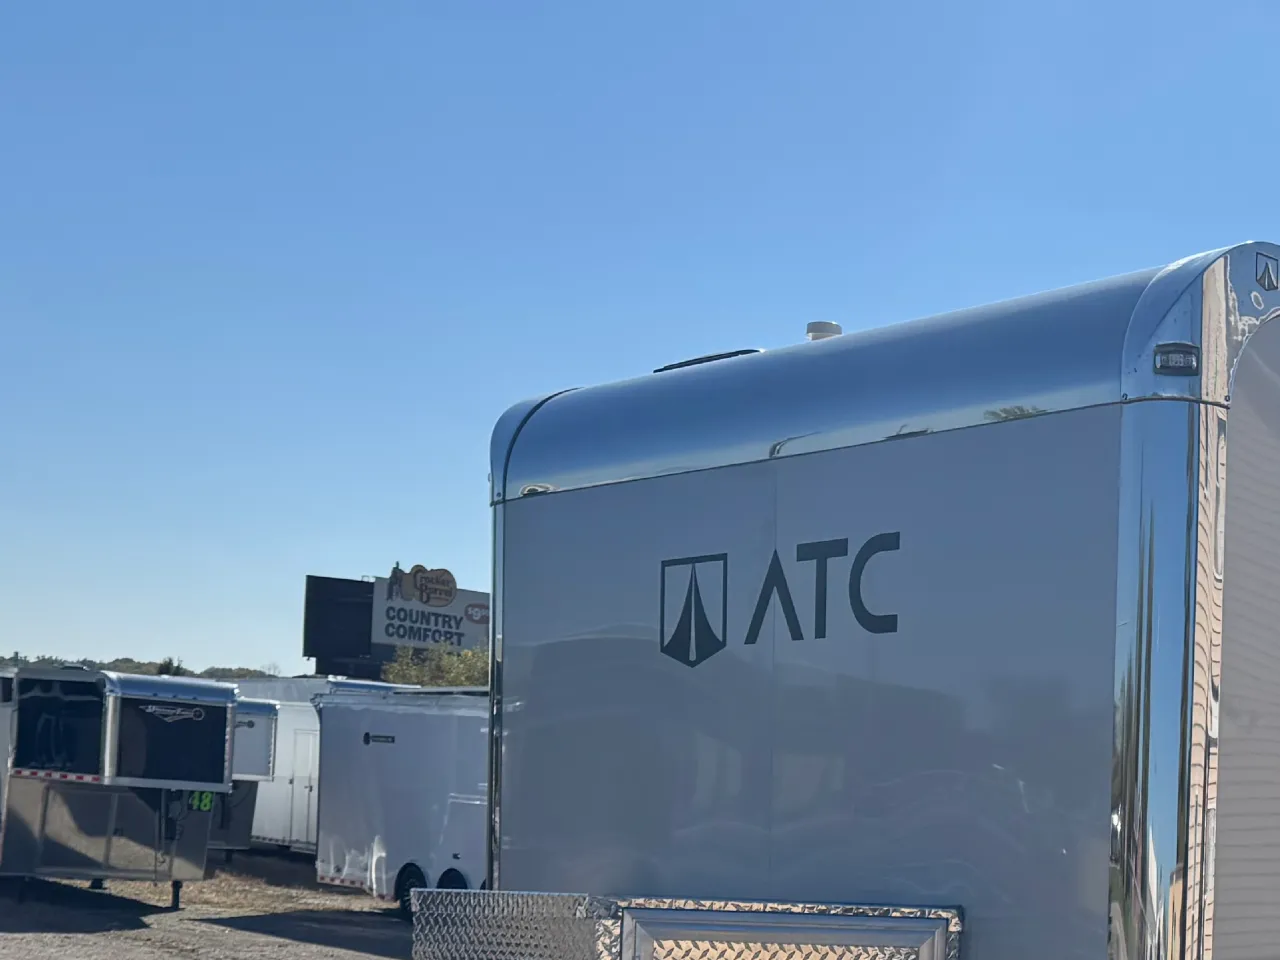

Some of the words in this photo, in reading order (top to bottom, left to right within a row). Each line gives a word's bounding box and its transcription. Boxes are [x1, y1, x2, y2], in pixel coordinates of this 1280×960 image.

[744, 531, 900, 645] ATC
[386, 606, 463, 630] COUNTRY
[385, 623, 465, 646] COMFORT
[189, 791, 213, 811] 48
